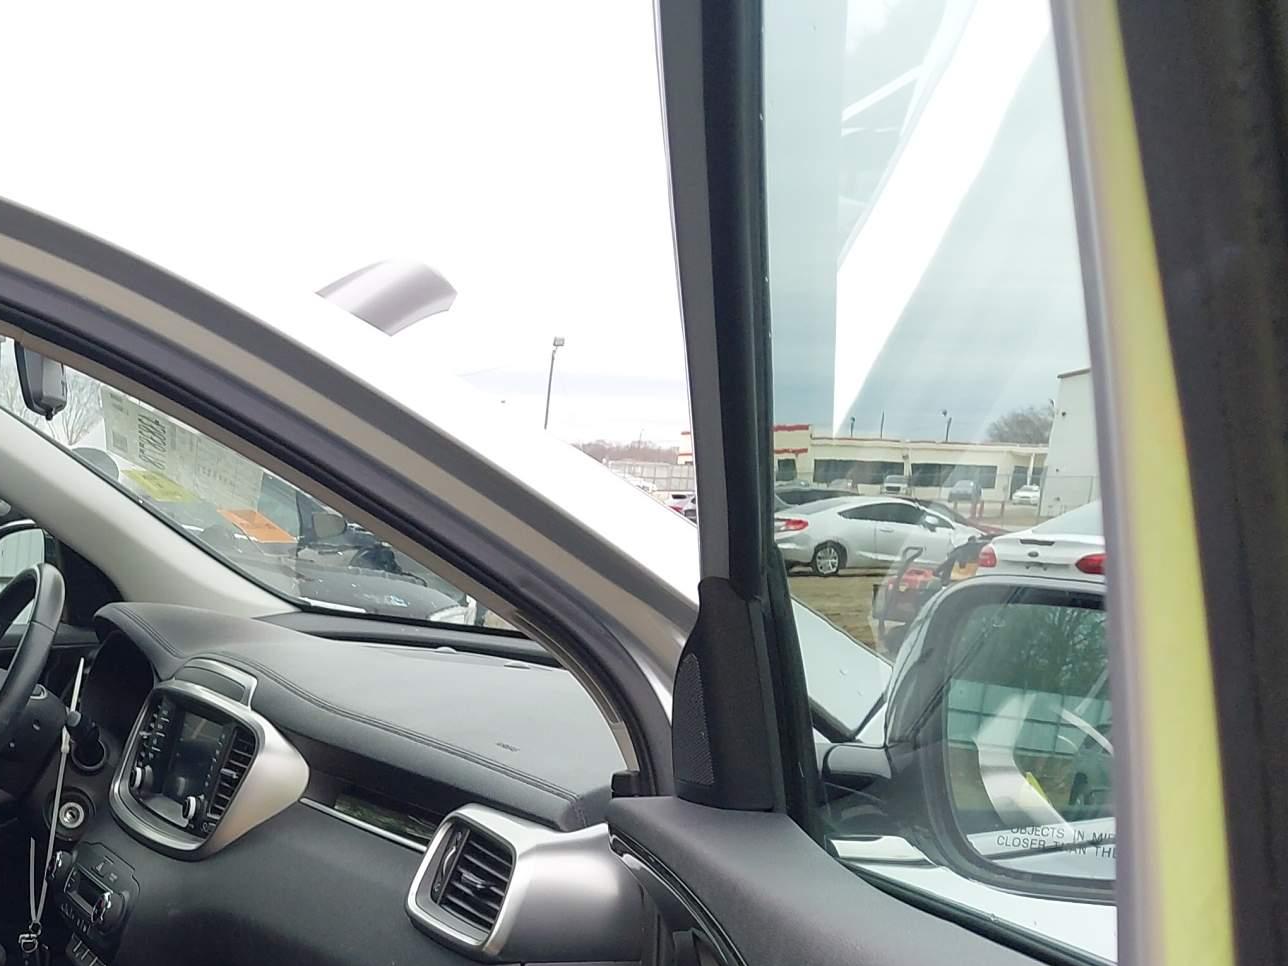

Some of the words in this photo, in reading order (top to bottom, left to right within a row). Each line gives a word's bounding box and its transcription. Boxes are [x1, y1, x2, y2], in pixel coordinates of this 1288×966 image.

[1011, 825, 1065, 838] OBJECTS
[1073, 829, 1085, 842] IN
[997, 836, 1046, 850] CLOSER
